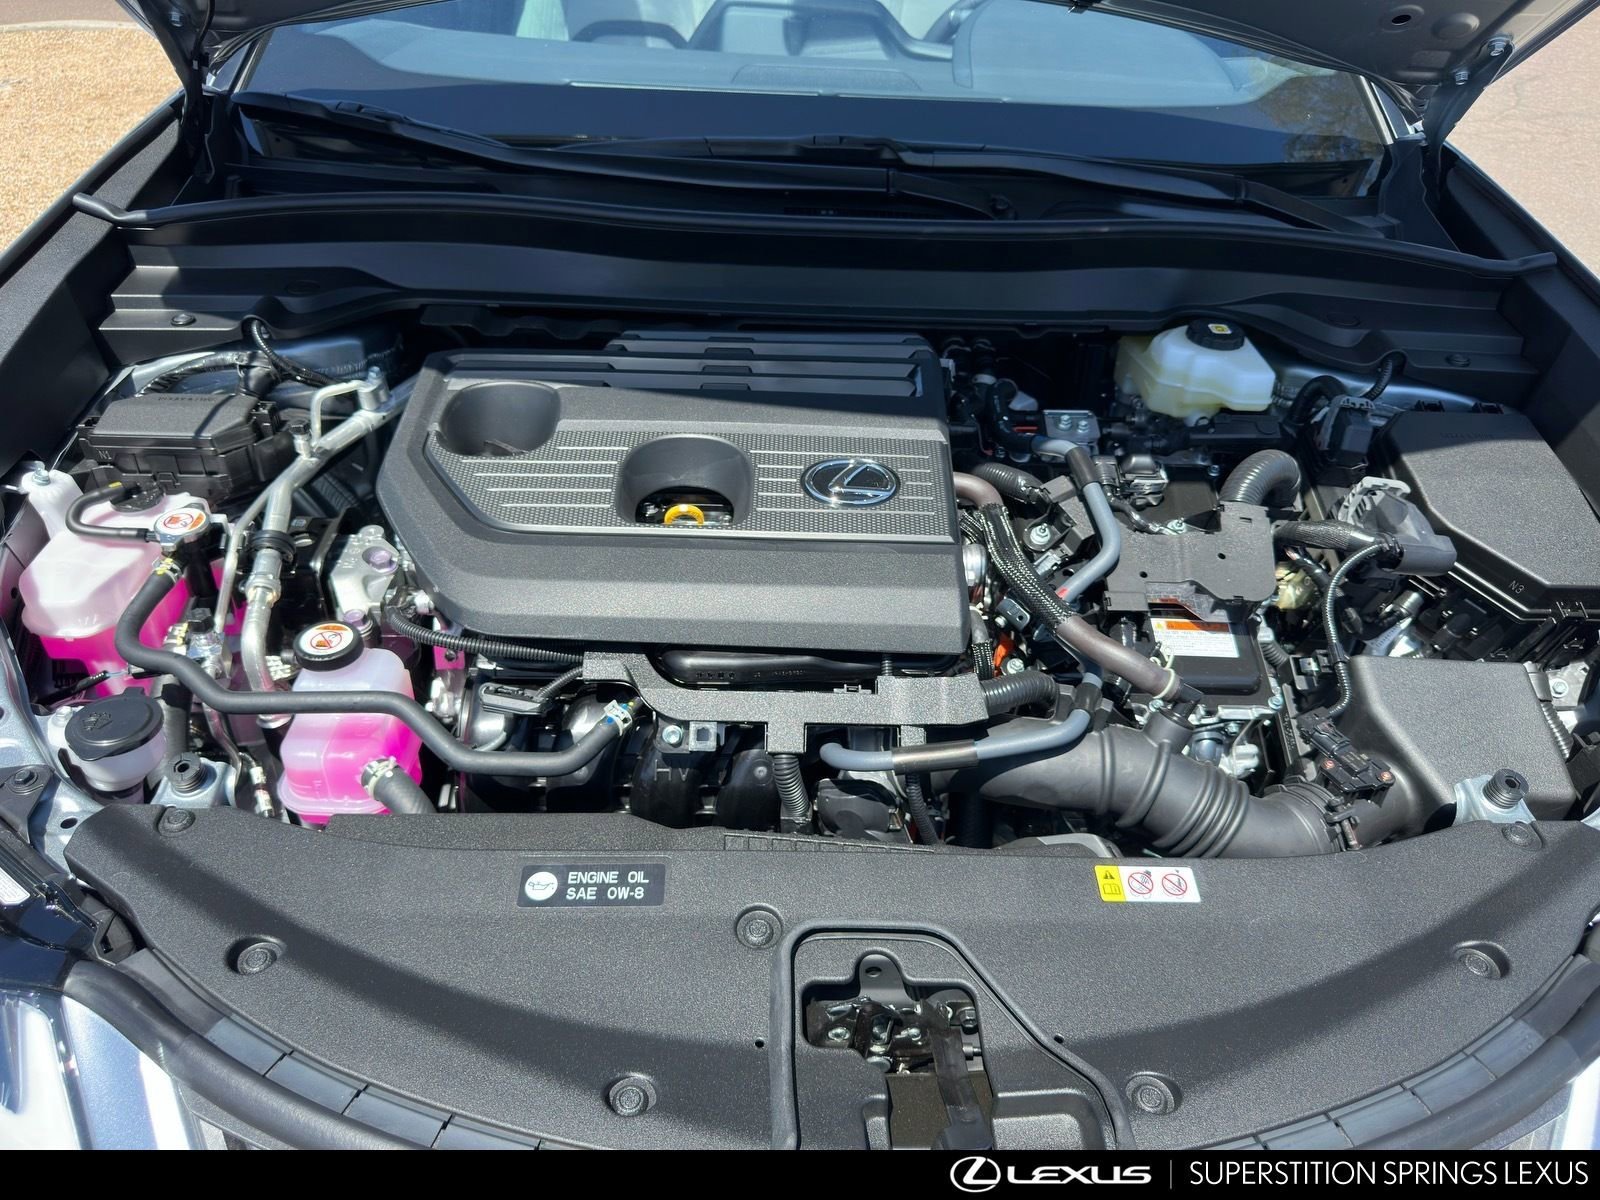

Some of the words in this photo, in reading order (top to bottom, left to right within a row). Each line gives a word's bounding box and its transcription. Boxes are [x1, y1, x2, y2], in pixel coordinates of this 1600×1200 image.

[1508, 580, 1525, 594] N3
[654, 759, 690, 781] HV
[567, 871, 619, 884] ENGINE
[627, 870, 649, 883] OIL
[565, 886, 597, 900] SAE
